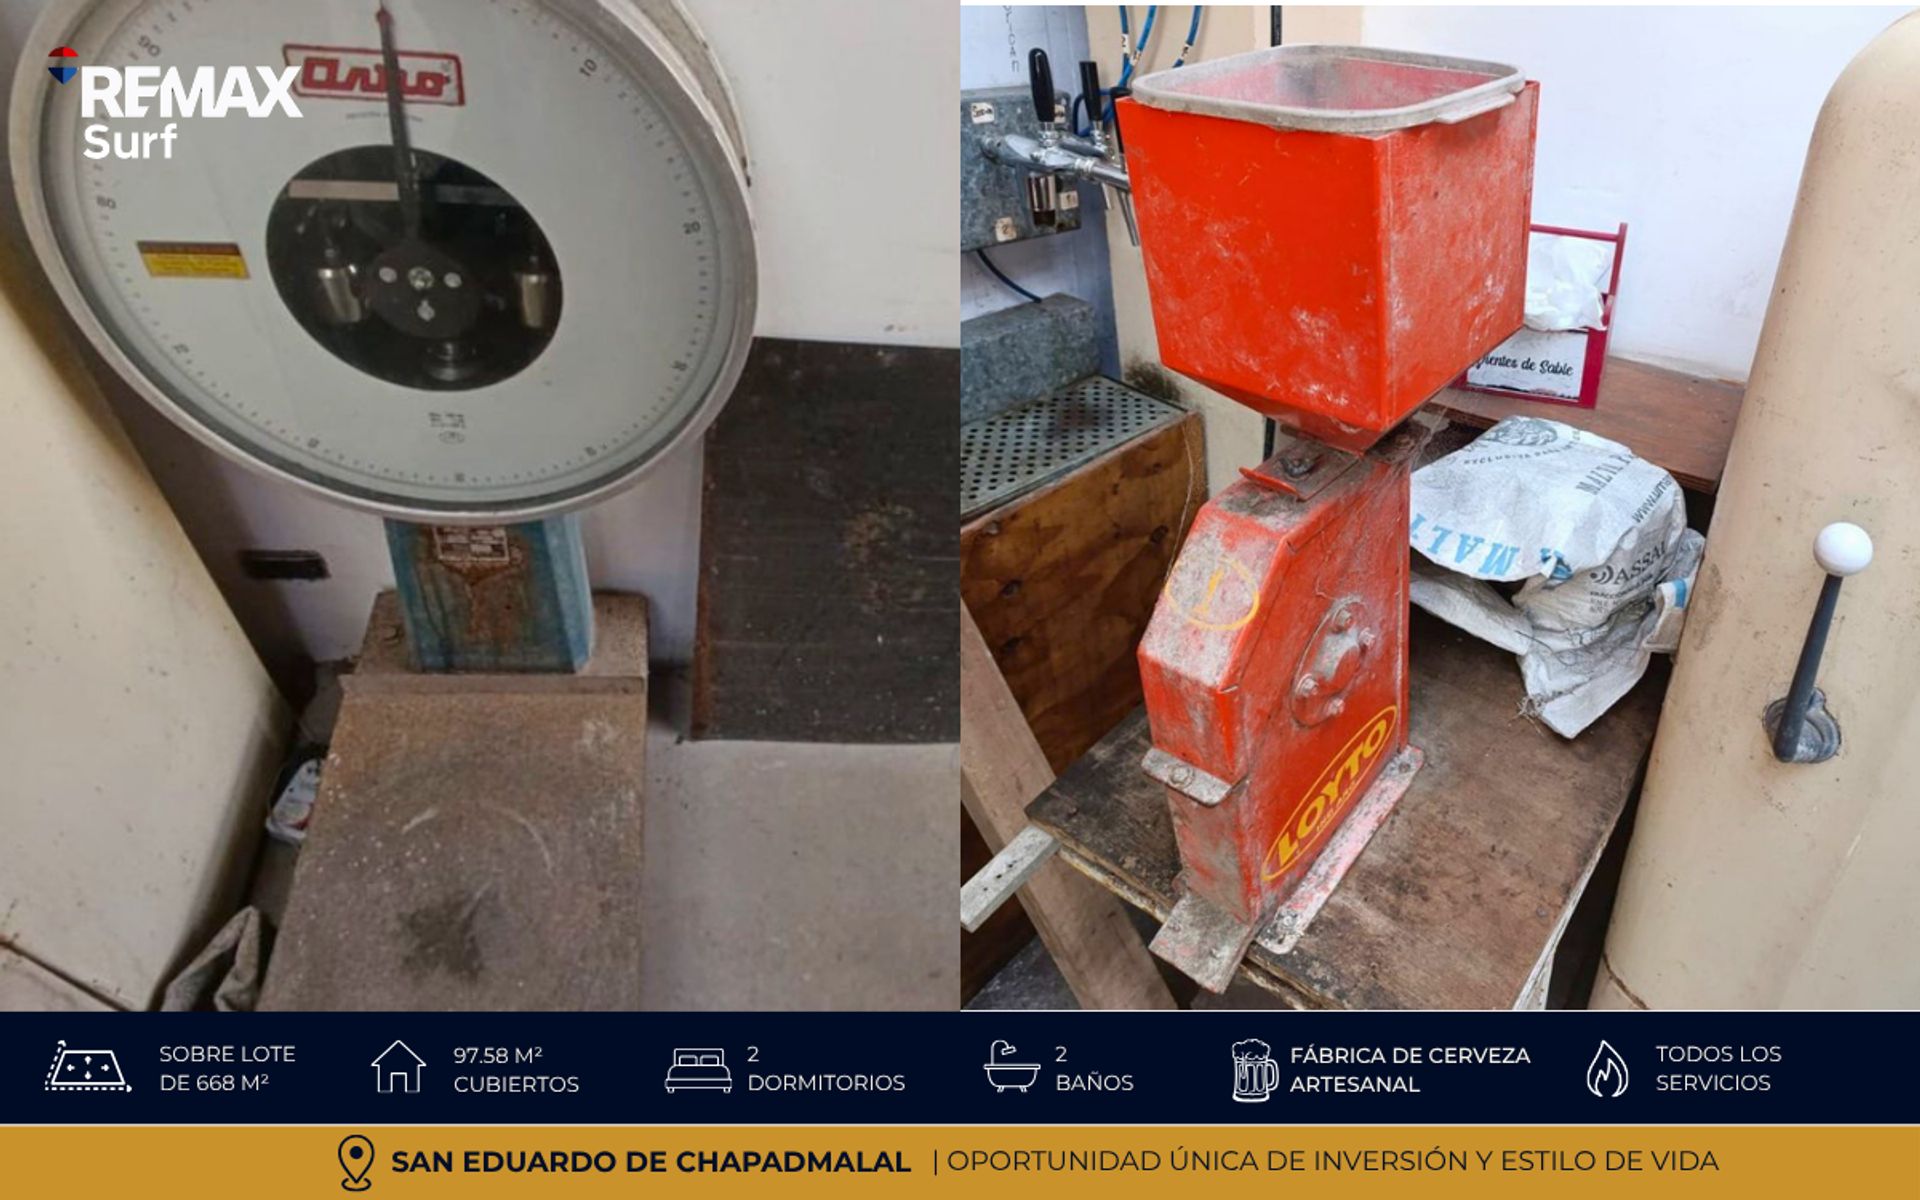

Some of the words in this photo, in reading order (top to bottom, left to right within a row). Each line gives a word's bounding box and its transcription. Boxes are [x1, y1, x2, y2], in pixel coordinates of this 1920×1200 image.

[578, 58, 598, 78] 10
[682, 221, 701, 235] 20
[1521, 357, 1536, 371] de
[1540, 360, 1575, 376] Sable
[1277, 718, 1388, 868] LOYTO
